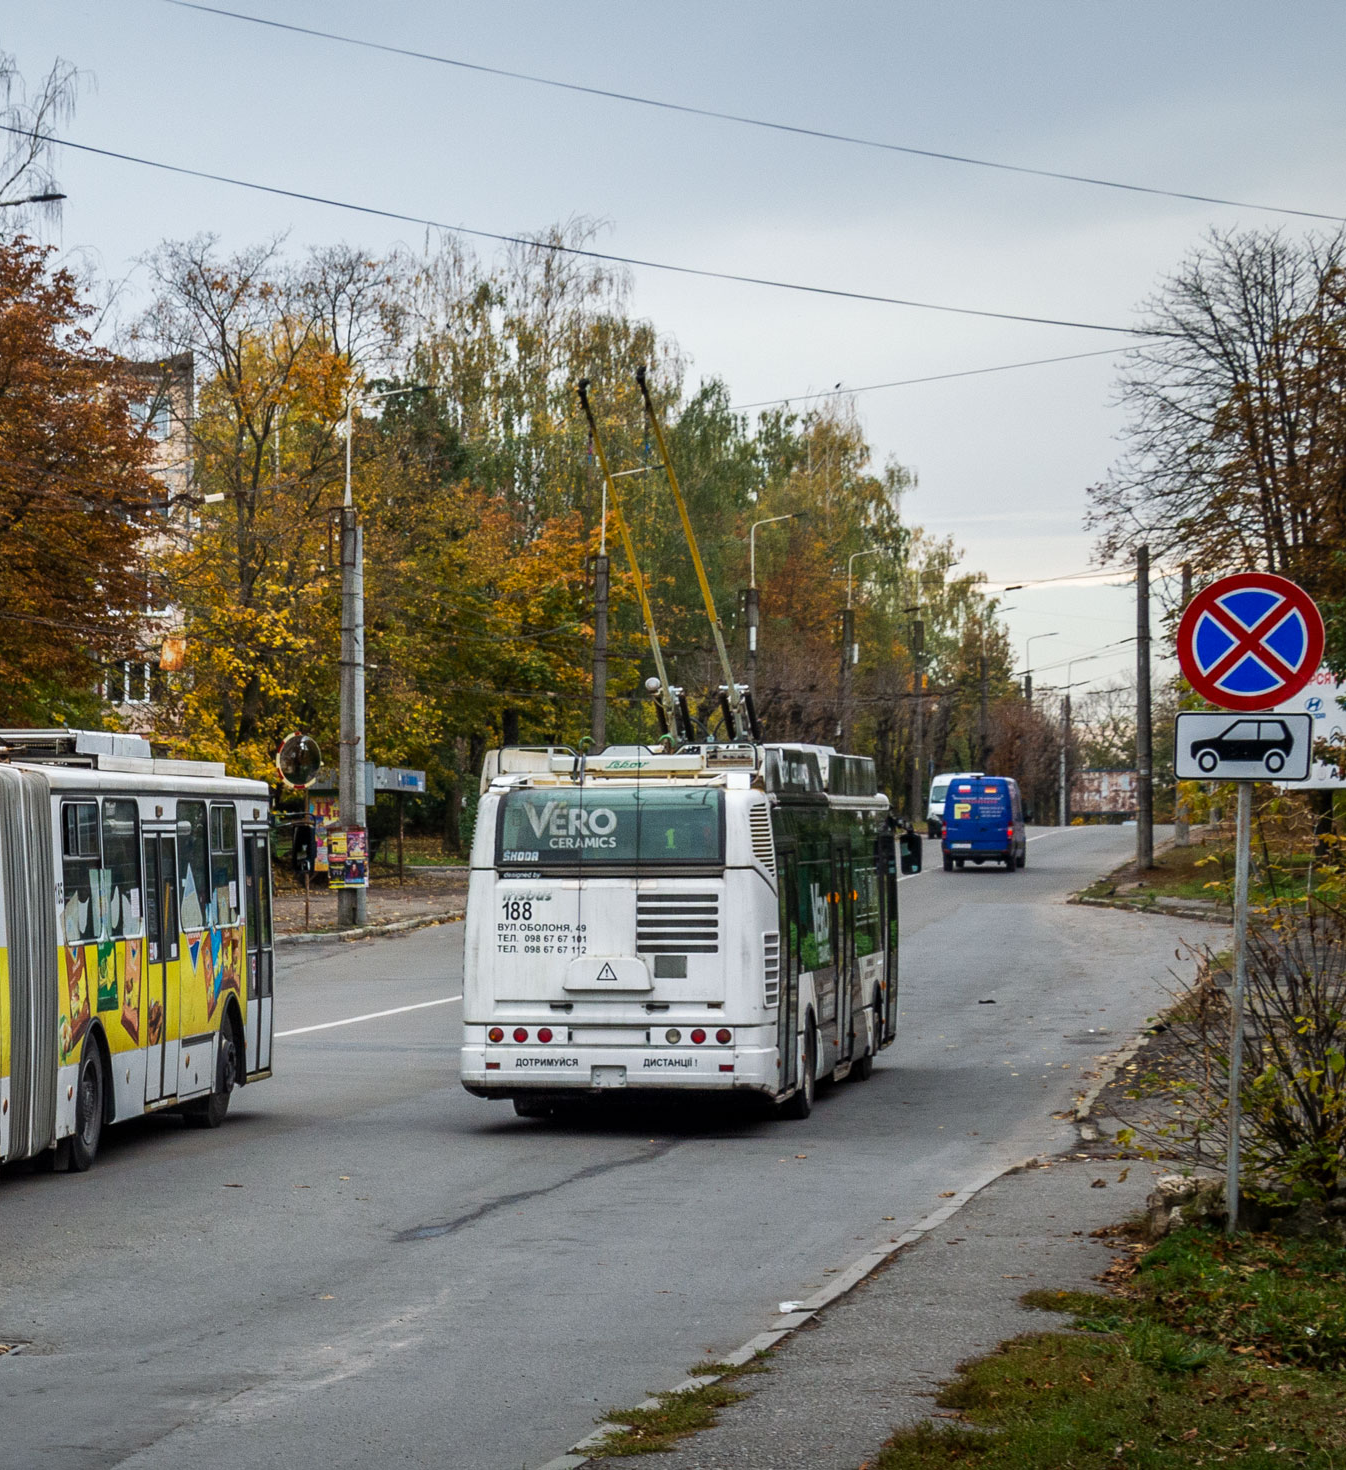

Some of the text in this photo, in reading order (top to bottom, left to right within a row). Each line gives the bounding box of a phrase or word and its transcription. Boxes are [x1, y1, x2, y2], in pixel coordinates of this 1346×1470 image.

[549, 836, 617, 850] CERAMICS
[664, 828, 676, 849] 1
[503, 871, 541, 879] designed by
[502, 901, 532, 921] 188
[575, 924, 587, 933] 49
[497, 934, 519, 943] ТЕЛ.
[524, 934, 541, 943] 098
[543, 934, 554, 943] 67
[557, 934, 568, 943] 67
[497, 945, 519, 953] ТЕЛ.
[524, 945, 541, 954] 098
[543, 945, 554, 954] 67
[557, 946, 568, 954] 67
[515, 1056, 579, 1068] ДОТРИМУЙСЯ
[643, 1057, 693, 1069] ДИСТАНЦІЇ
